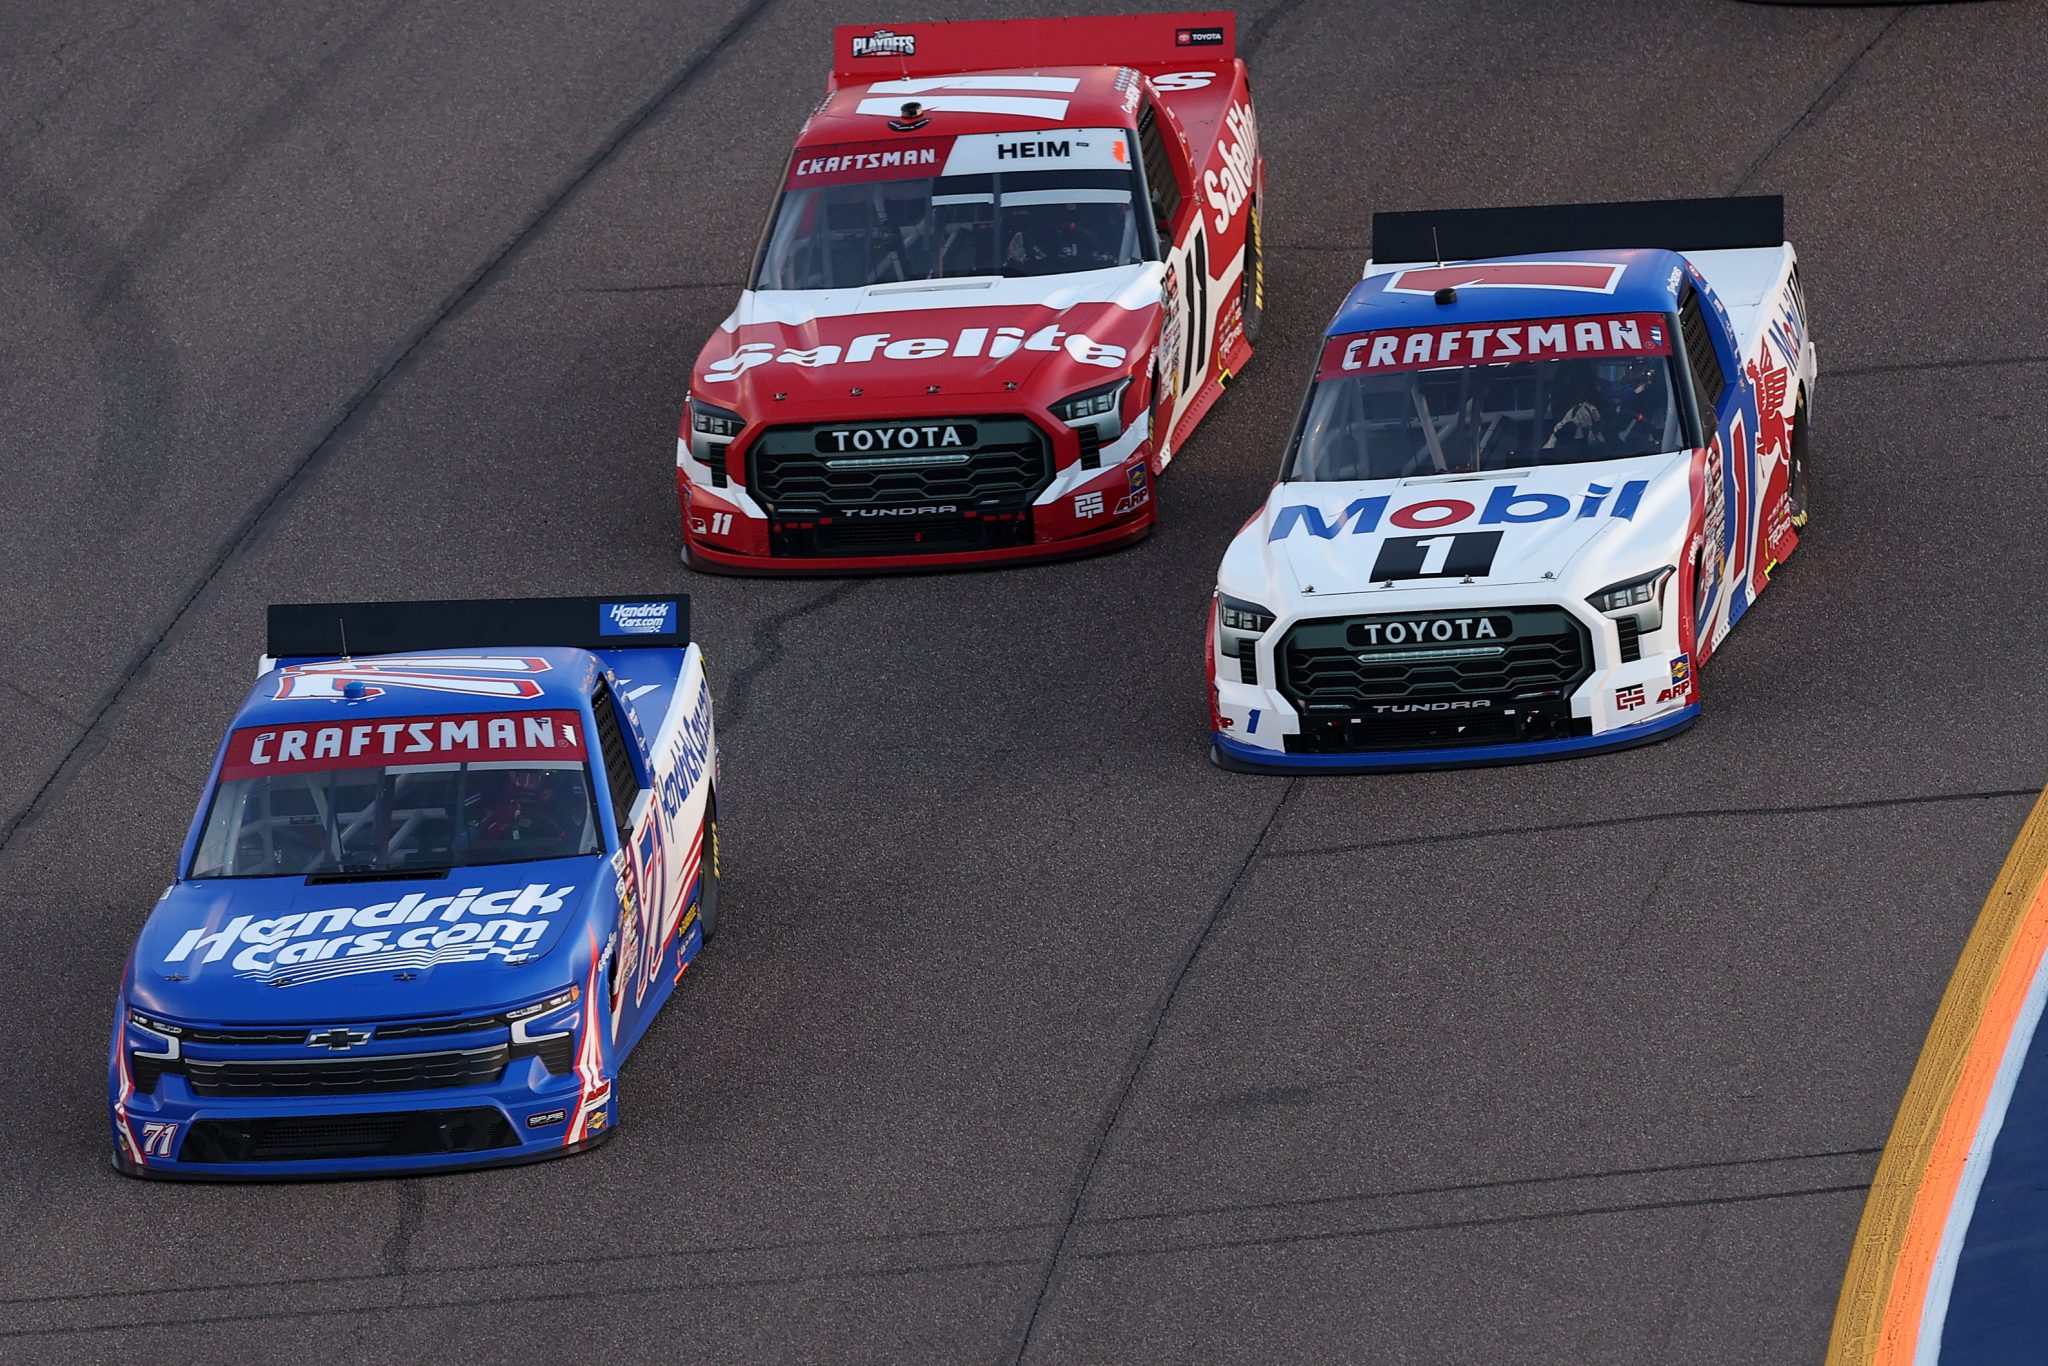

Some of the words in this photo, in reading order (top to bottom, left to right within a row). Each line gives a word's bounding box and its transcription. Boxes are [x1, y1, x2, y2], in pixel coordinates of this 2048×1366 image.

[853, 35, 914, 56] PLAYOFFS
[796, 148, 936, 176] CRAFTSMAN
[998, 140, 1070, 160] HEIM
[703, 324, 1127, 383] Safelite
[1341, 320, 1642, 371] CRAFTSMAN
[832, 426, 962, 451] TOYOTA
[711, 512, 733, 535] 11
[841, 505, 957, 517] TUNDRA
[1267, 480, 1650, 544] Mobil
[1416, 535, 1455, 575] 1
[609, 603, 669, 621] Hendrick
[618, 617, 664, 627] Cars.com
[1364, 618, 1497, 645] TOYOTA
[1656, 680, 1691, 704] ARP
[1372, 700, 1491, 713] TUNDRA
[1246, 708, 1261, 734] 1
[250, 717, 554, 765] CRAFTSMAN
[164, 883, 576, 964] Hendrick
[233, 919, 550, 971] Cars.com
[143, 1121, 178, 1157] 71
